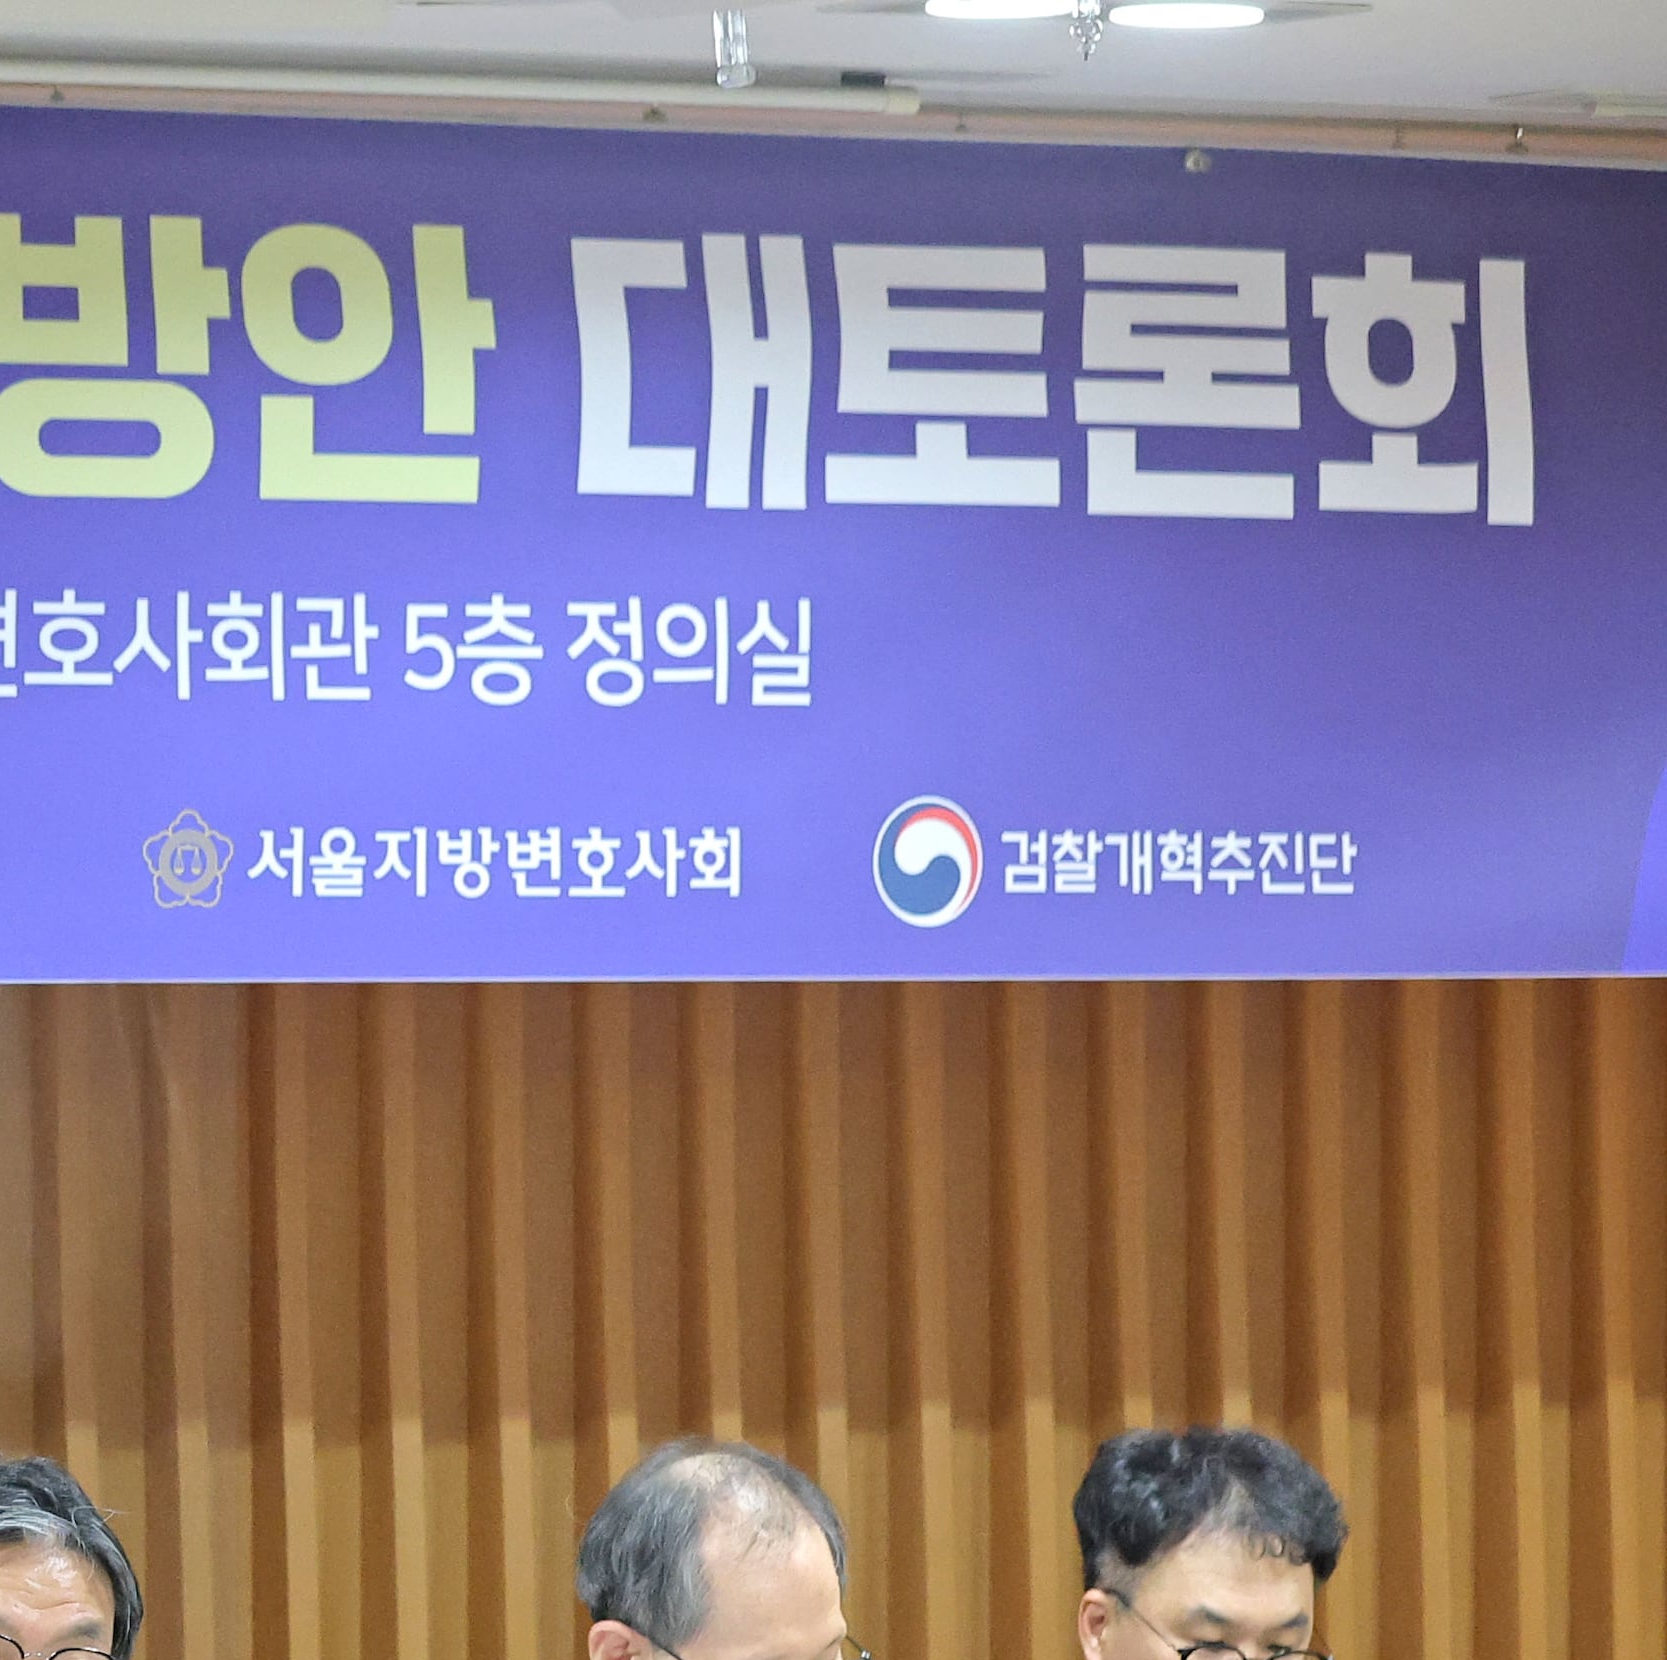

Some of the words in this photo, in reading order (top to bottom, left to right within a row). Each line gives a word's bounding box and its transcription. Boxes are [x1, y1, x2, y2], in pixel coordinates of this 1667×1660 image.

[571, 235, 1533, 525] 대토론회
[405, 594, 543, 705] 5층
[567, 597, 811, 706] 정의실
[248, 827, 740, 898] 서울지방변호사회
[1002, 830, 1357, 894] 검찰개혁추진단
